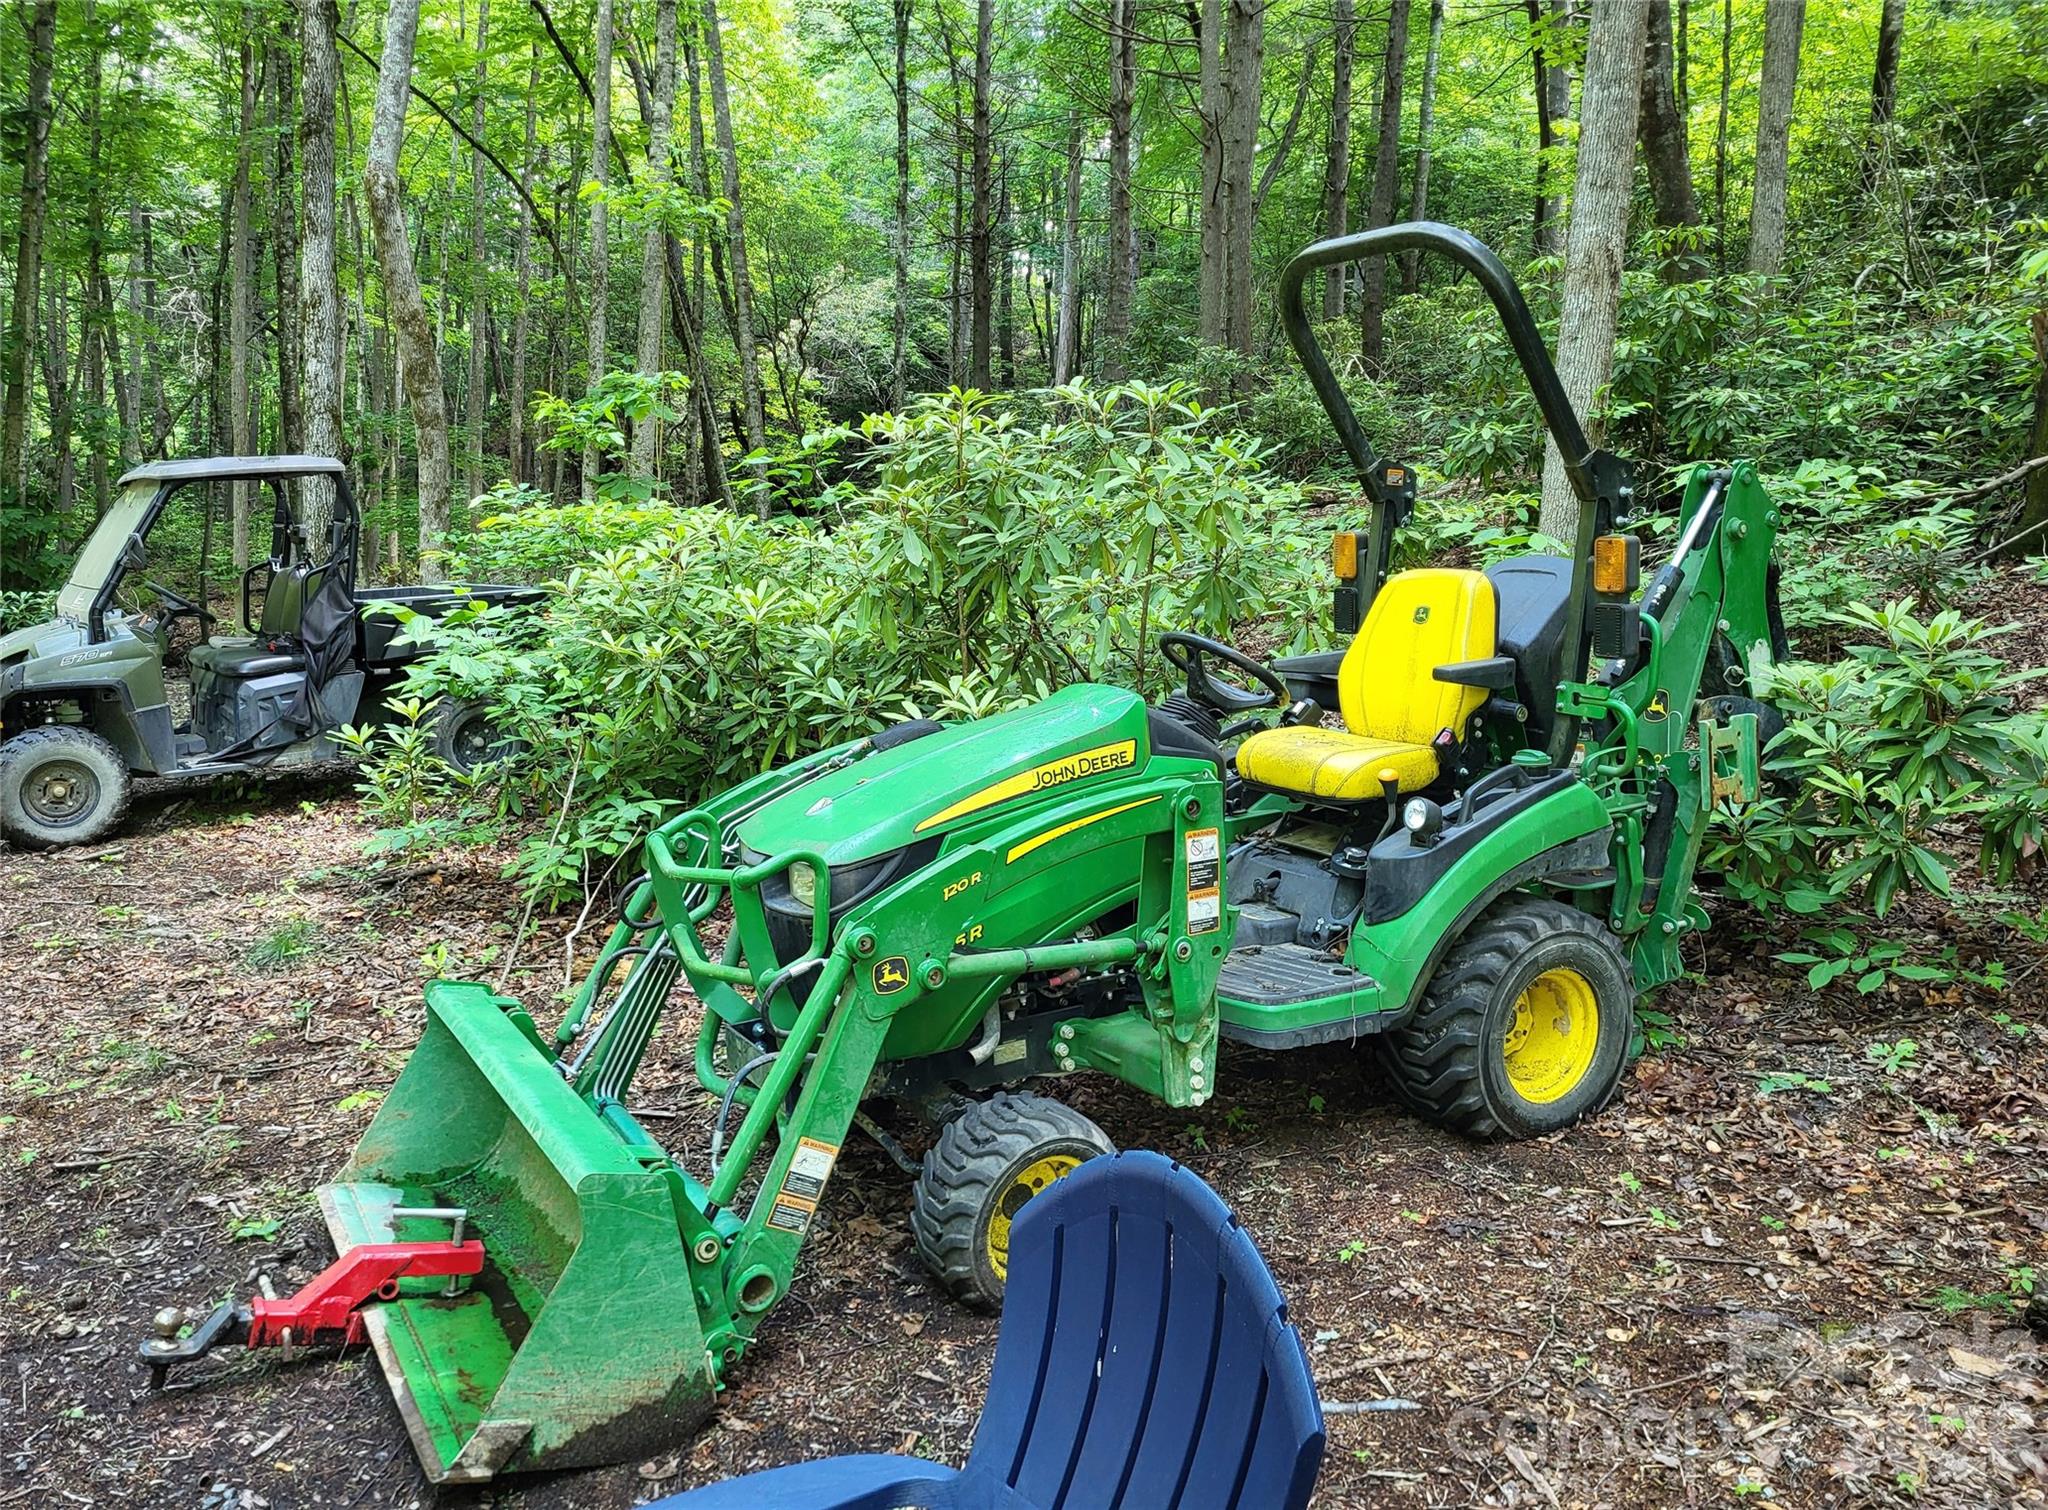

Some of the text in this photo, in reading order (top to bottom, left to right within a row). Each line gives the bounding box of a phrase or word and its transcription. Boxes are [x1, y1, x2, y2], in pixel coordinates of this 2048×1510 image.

[1032, 750, 1129, 789] JOHN DEERE
[1193, 829, 1217, 837] WARNING
[1194, 891, 1218, 899] WARNING
[810, 1142, 833, 1152] WARNING
[787, 1199, 811, 1208] WARNING
